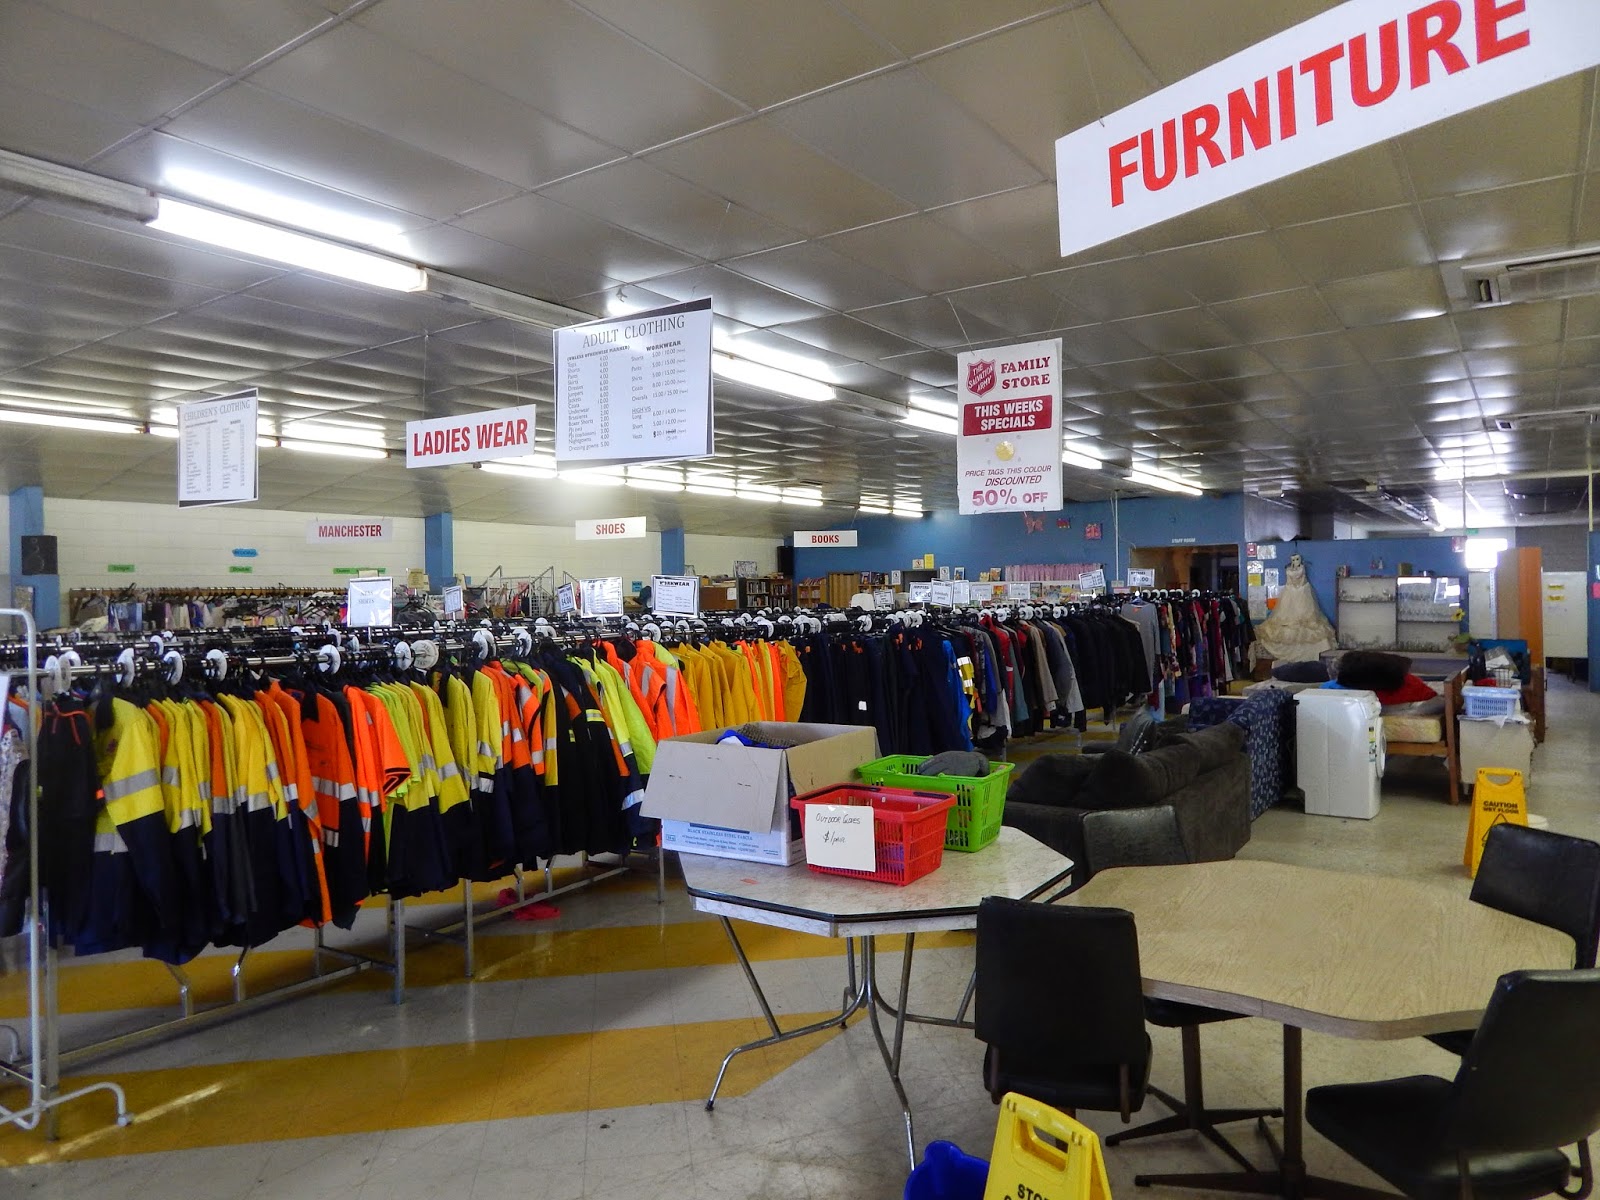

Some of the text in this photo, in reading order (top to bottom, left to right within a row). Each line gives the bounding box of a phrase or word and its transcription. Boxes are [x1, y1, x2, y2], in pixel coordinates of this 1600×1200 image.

[1108, 0, 1530, 208] FURNITURE
[582, 315, 685, 348] ADULT CLOTHING
[646, 340, 681, 351] WORKWEAR
[973, 364, 983, 376] THE
[1001, 356, 1050, 373] FAMILY
[968, 365, 993, 388] SALVATION
[977, 376, 991, 392] ARMY
[1002, 374, 1050, 389] STORE
[220, 400, 250, 414] CLOTHING
[975, 400, 1043, 417] THIS WEEKS
[981, 415, 1035, 431] SPECIALS
[413, 418, 528, 457] LADIES WEAR
[1024, 465, 1051, 473] COLOUR
[985, 475, 1042, 486] DISCOUNTED
[972, 489, 1048, 506] 50% OFF
[318, 524, 382, 538] MANCHESTER
[595, 523, 626, 535] SHOES
[811, 535, 840, 544] BOOKS
[1018, 1183, 1050, 1200] ST
